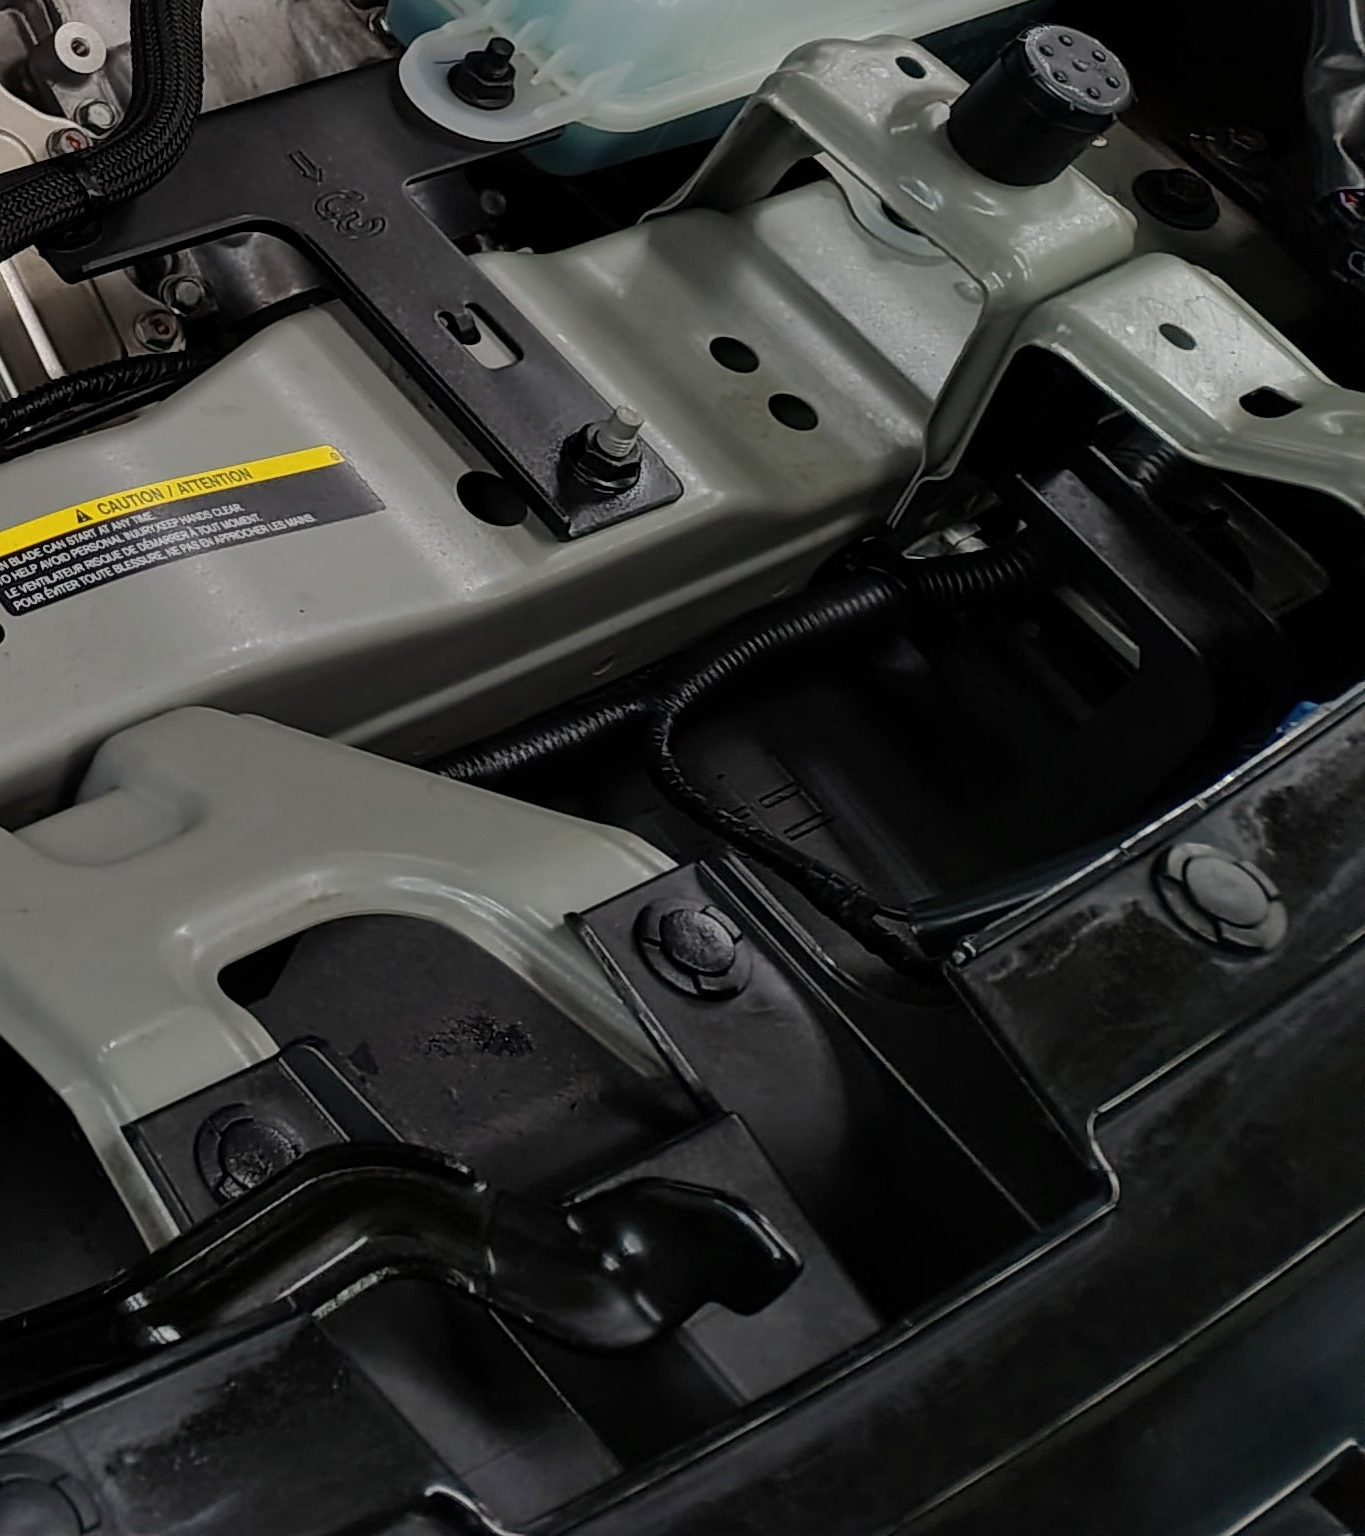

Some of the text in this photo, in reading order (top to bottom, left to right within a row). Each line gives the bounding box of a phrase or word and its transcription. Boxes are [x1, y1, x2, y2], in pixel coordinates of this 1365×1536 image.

[96, 486, 165, 515] CAUTION
[177, 467, 253, 496] ATTENTION
[4, 587, 21, 600] LE
[19, 563, 86, 595] VENTILATEUR
[85, 550, 124, 571] RISQUE
[124, 544, 138, 557] DE
[197, 520, 222, 536] TOUT
[8, 549, 44, 568] BLADE
[42, 539, 67, 555] CAN
[66, 527, 98, 547] START
[98, 522, 111, 535] AT
[110, 516, 136, 532] ANY
[11, 562, 39, 582] HELP
[40, 552, 72, 571] AVOID
[71, 533, 126, 562] PERSONAL
[180, 509, 213, 527] HANDS
[12, 591, 46, 612] POUR
[44, 578, 81, 600] ÉVITER
[80, 567, 115, 586] TOUTE
[166, 544, 182, 558] NE
[181, 538, 201, 554] PAS
[200, 534, 216, 550] EN
[214, 524, 271, 548] APPROCHER
[269, 518, 288, 531] LES
